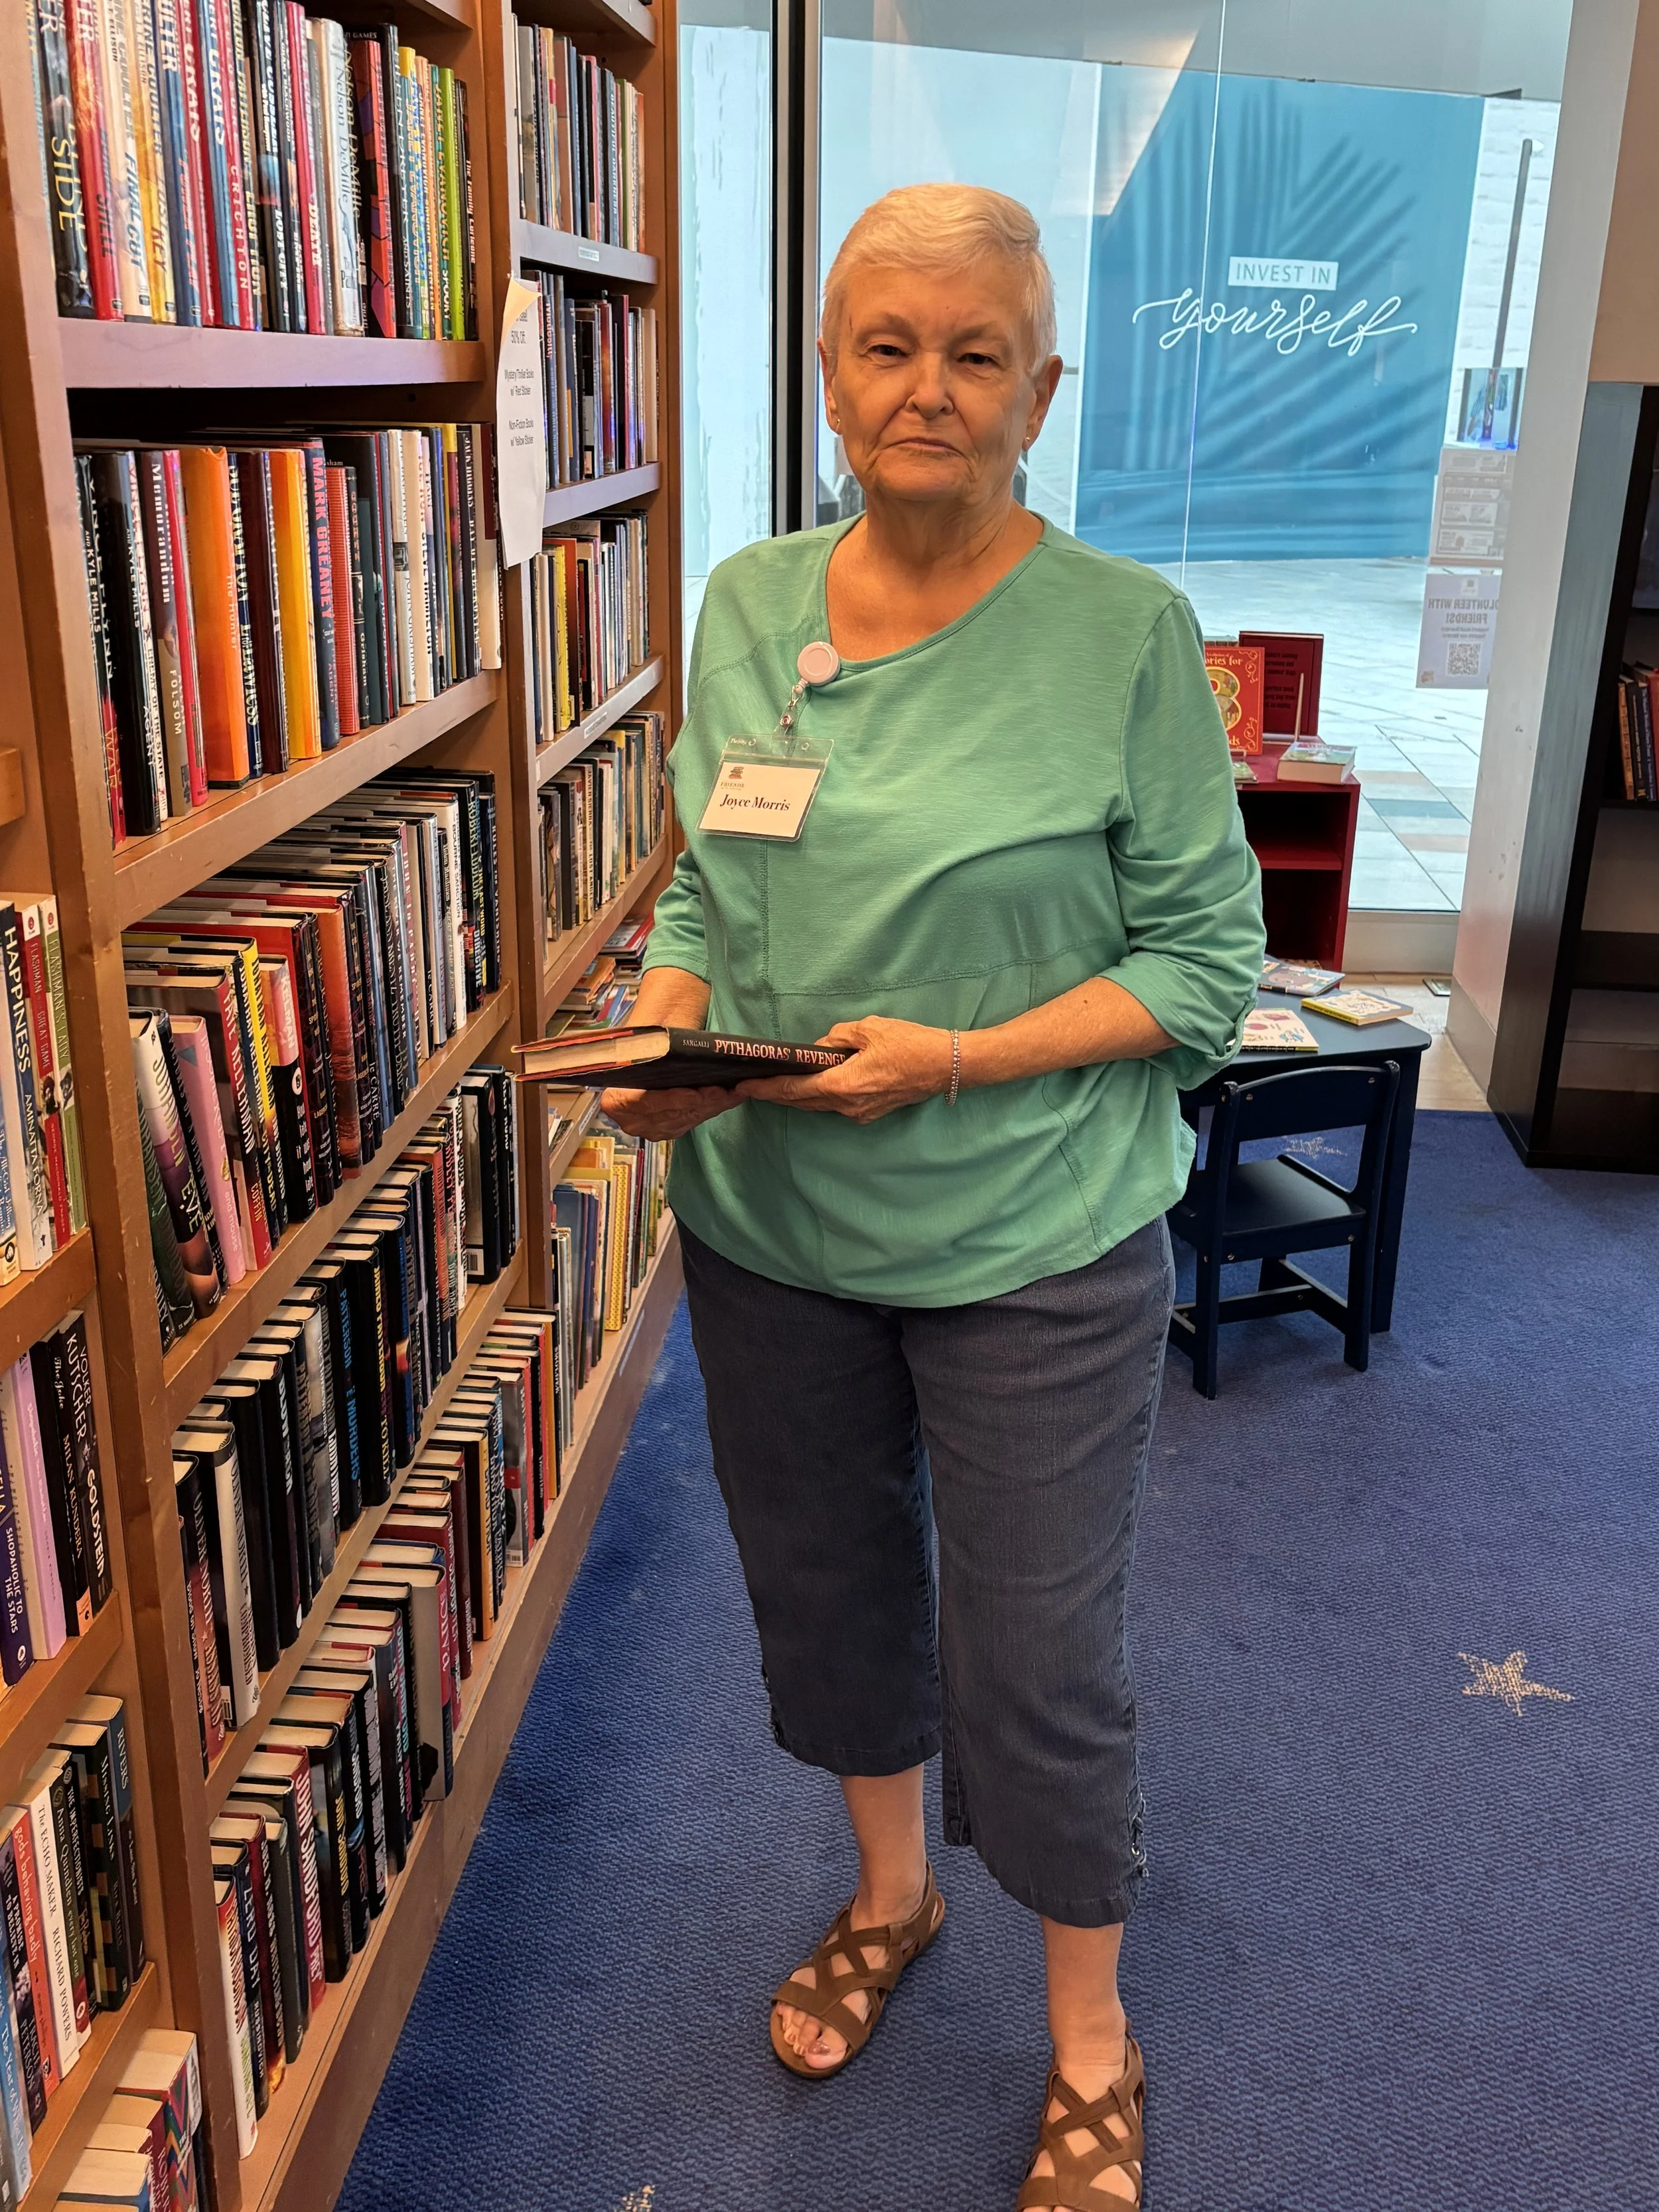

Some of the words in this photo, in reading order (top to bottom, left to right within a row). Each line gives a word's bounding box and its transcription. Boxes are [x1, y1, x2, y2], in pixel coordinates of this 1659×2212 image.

[186, 42, 200, 142] CRAIS
[210, 48, 225, 146] CRAIS
[267, 64, 278, 153] CUSSLER
[336, 66, 348, 126] Nelson
[344, 50, 356, 126] Nelson
[51, 136, 80, 231] SIDE
[125, 151, 141, 223] FINAL
[348, 133, 361, 219] DeMille
[435, 84, 444, 142] JANET
[442, 269, 451, 319] SPOOKY
[97, 193, 116, 258] SHELL
[128, 222, 145, 271] CUT
[231, 164, 249, 290] CRICHTON
[275, 208, 284, 250] LOST
[309, 201, 321, 266] DEATH
[279, 250, 288, 291] CITY
[1236, 262, 1305, 282] INVEST
[1311, 266, 1331, 284] IN
[312, 456, 327, 520] MARK
[151, 463, 171, 604] Memorandum
[88, 549, 97, 585] KYLE
[316, 524, 333, 620] GREANEY
[92, 590, 101, 631] MILLS
[230, 603, 240, 651] Hunter
[131, 587, 141, 628] MILLS
[142, 703, 155, 765] AGENT
[146, 646, 157, 691] ENEMY
[360, 631, 368, 688] Grisham
[1229, 655, 1243, 666] for
[151, 694, 158, 711] OF
[169, 669, 182, 733] FOLSOM
[104, 727, 117, 789] WAR
[155, 739, 165, 778] STATE
[720, 794, 751, 810] Joyce
[752, 796, 790, 812] Morris
[470, 852, 480, 900] LUDLUM
[31, 942, 43, 993] FLASHMAN
[388, 944, 398, 995] KRENTZ
[397, 940, 402, 960] WE
[474, 928, 482, 988] DIRECTIVE
[48, 938, 66, 1023] FLASHMAN'S
[239, 966, 253, 1037] JONATHAN
[251, 958, 266, 1029] JONATHAN
[398, 966, 407, 1039] REMEMBER
[36, 1010, 48, 1041] GREAT
[281, 976, 296, 1049] KELMAN
[4, 925, 31, 1073] HAPPINESS
[25, 1094, 41, 1163] AMINATTA
[33, 1164, 44, 1215] FORNA
[41, 1043, 51, 1069] GAME
[222, 991, 238, 1041] FAYE
[230, 1045, 255, 1155] KELLERMAN
[714, 1039, 791, 1061] PYTHAGORAS'
[248, 1041, 265, 1124] KELLERMAN
[261, 1129, 272, 1165] CITY
[180, 1181, 200, 1233] EVE
[224, 1191, 235, 1213] and
[250, 1183, 263, 1222] COFFIN
[266, 1170, 277, 1212] DEAD
[228, 1214, 238, 1252] mouse
[448, 1260, 457, 1288] DAVID
[449, 1290, 458, 1317] HAYES
[54, 1357, 65, 1380] The
[78, 1346, 92, 1406] VOLKER
[340, 1288, 352, 1369] PATTERSON
[346, 1398, 361, 1482] MURDERS
[54, 1381, 66, 1410] Joke
[319, 1361, 329, 1439] Horsewoman
[380, 1414, 389, 1438] TO
[63, 1434, 75, 1483] MILAN
[66, 1333, 88, 1443] KUTSCHER
[86, 1468, 106, 1578] GOLDSTEIN
[382, 1437, 392, 1480] KILL
[230, 1461, 242, 1525] OLIVER
[68, 1487, 83, 1560] KUNDERA
[192, 1492, 207, 1563] OLIVER
[6, 1527, 21, 1591] SHOPAHOLIC
[15, 1599, 23, 1615] TO
[236, 1527, 249, 1585] NORTH
[5, 1576, 13, 1595] THE
[199, 1560, 214, 1625] NORTH
[6, 1595, 18, 1634] STARS
[239, 1603, 254, 1686] COMPROMISED
[398, 1673, 410, 1753] SANDFORD
[116, 1726, 130, 1790] RIVERS
[351, 1745, 364, 1820] SANDFORD
[66, 1786, 76, 1806] THE
[295, 1773, 314, 1833] JOHN
[334, 1791, 347, 1831] John
[14, 1826, 29, 1859] gods
[40, 1828, 50, 1868] ECHO
[57, 1806, 66, 1842] Anna
[60, 1844, 74, 1906] Quindlen
[70, 1808, 84, 1897] IMPERFECTIONISTS
[261, 1840, 270, 1876] JOEL
[337, 1831, 350, 1896] Sandford
[356, 1846, 370, 1903] PREY
[5, 1895, 12, 1908] TO
[21, 1857, 38, 1923] behaving
[44, 1868, 58, 1917] MAKER
[244, 1887, 257, 1944] ZERO
[301, 1830, 322, 1948] SANDFORD
[7, 1910, 18, 1953] BELIEVE
[13, 1903, 24, 1951] PROMISE
[28, 1923, 42, 1964] badly
[67, 1910, 76, 1937] every
[71, 1937, 80, 1956] last
[52, 1927, 67, 1986] RICHARD
[248, 1951, 260, 1990] DAY
[309, 1949, 323, 1983] PREY
[1, 2022, 11, 2054] The
[60, 1988, 72, 2041] POWERS
[255, 2000, 265, 2079] RUSSINOVICH
[20, 2021, 36, 2092] PETERSON
[29, 2016, 42, 2067] TRACIE
[5, 2055, 15, 2087] Year
[9, 2089, 16, 2102] of
